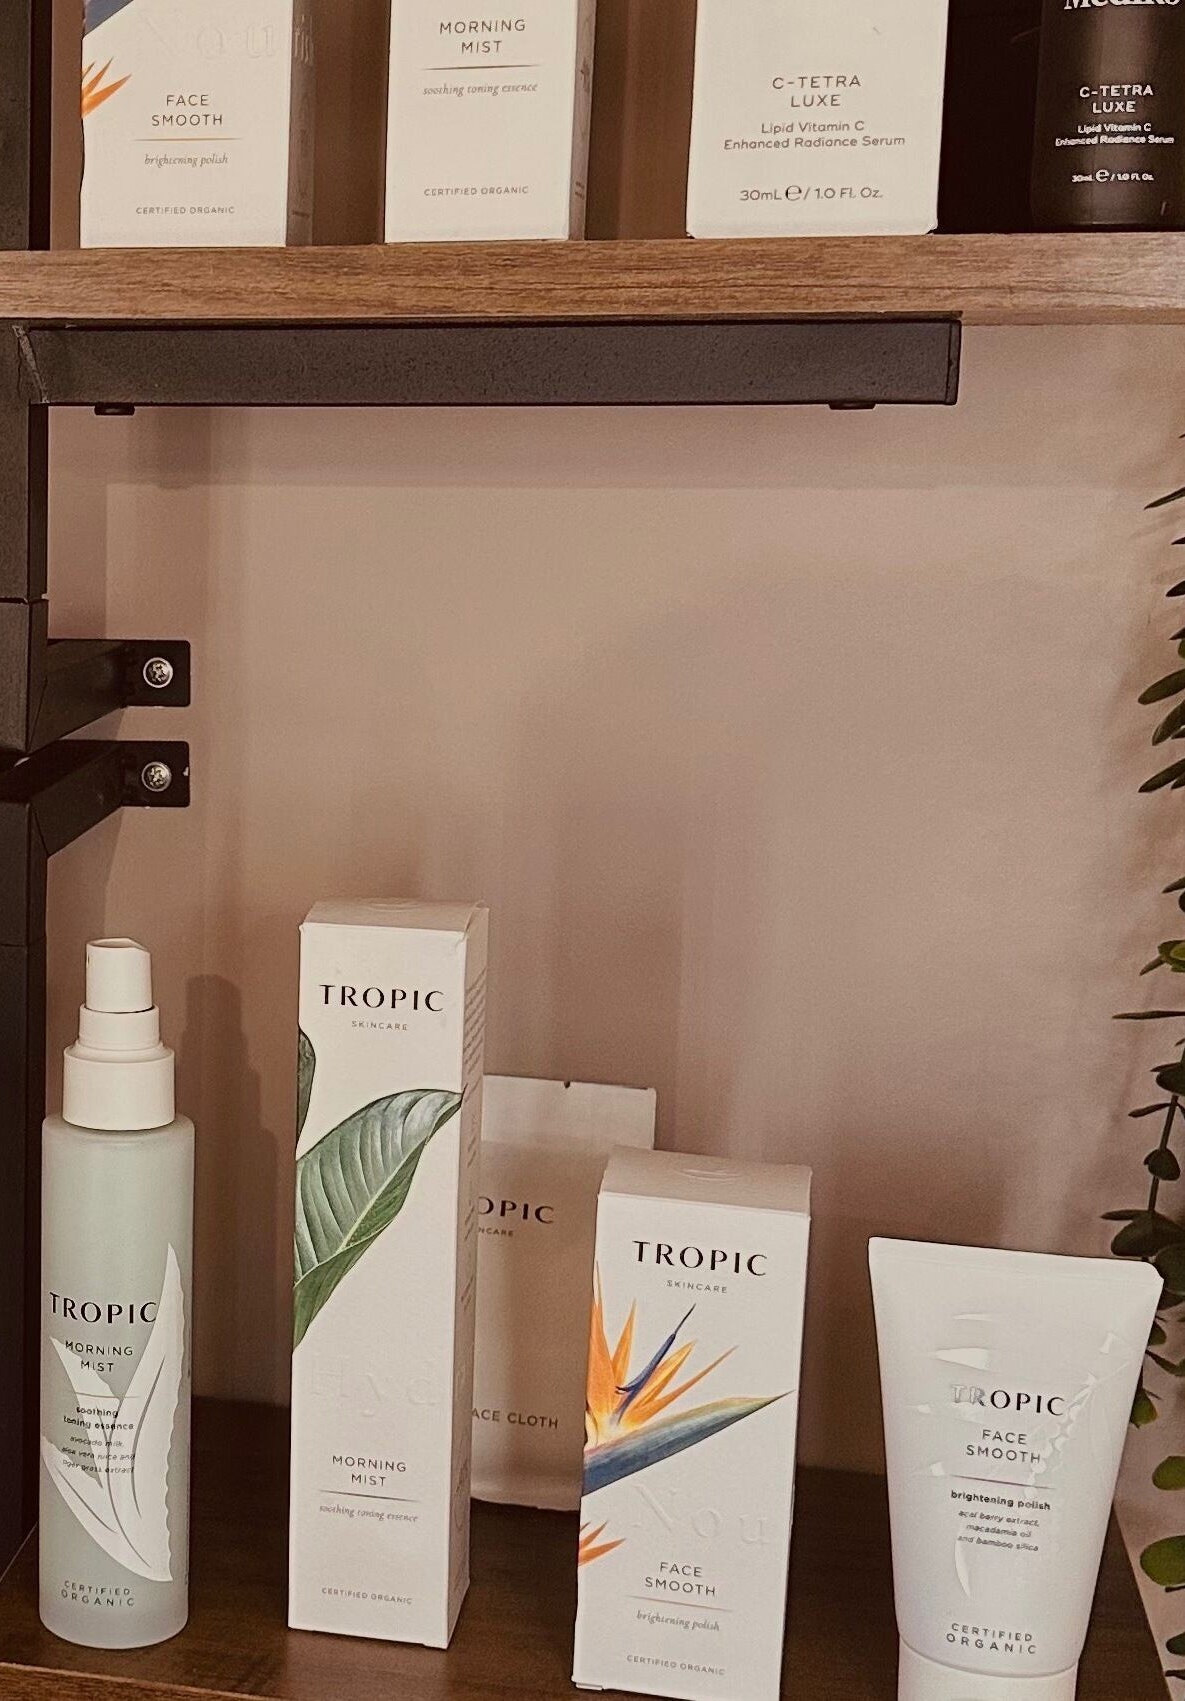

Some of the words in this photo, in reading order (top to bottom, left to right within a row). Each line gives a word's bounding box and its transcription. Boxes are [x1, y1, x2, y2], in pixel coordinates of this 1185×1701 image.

[439, 18, 527, 35] MORNING
[460, 40, 503, 55] MIST
[422, 83, 464, 97] soothing
[467, 83, 500, 97] toning
[502, 82, 538, 94] essence
[772, 75, 861, 90] C-TETRA
[1079, 85, 1154, 98] C-TETRA
[165, 94, 209, 107] FACE
[790, 95, 841, 108] LUXE
[1092, 101, 1136, 114] LUXE
[151, 113, 223, 127] SMOOTH
[761, 121, 794, 134] Lipid
[798, 121, 851, 133] Vitamin
[855, 121, 865, 131] C
[1143, 122, 1152, 132] C
[724, 137, 790, 150] Enhanced
[794, 136, 858, 148] Radiance
[861, 135, 906, 147] Serum
[144, 153, 197, 168] brightening
[199, 153, 229, 167] polish
[423, 187, 478, 197] CERTIFIED
[480, 185, 530, 196] ORGANIC
[135, 206, 186, 216] CERTIFIED
[189, 205, 236, 215] ORGANIC
[319, 984, 445, 1012] TROPIC
[351, 1020, 408, 1031] SKINCARE
[477, 1196, 555, 1225] OPIC
[477, 1226, 515, 1238] NCARE
[632, 1240, 768, 1277] TROPIC
[665, 1279, 728, 1294] SKINCARE
[49, 1291, 158, 1324] TROPIC
[64, 1339, 134, 1356] MORNING
[80, 1359, 115, 1373] MIST
[951, 1384, 1066, 1417] TROPIC
[76, 1406, 119, 1418] soothing
[471, 1408, 501, 1422] ACE
[507, 1412, 560, 1430] CLOTH
[982, 1429, 1028, 1445] FACE
[966, 1444, 1041, 1464] SMOOTH
[331, 1454, 407, 1473] MORNING
[350, 1473, 387, 1487] MIST
[951, 1490, 1014, 1508] brightening
[1017, 1499, 1051, 1511] polish
[319, 1505, 355, 1519] soothing
[386, 1513, 419, 1523] essence
[659, 1561, 703, 1578] FACE
[64, 1580, 131, 1597] CERTIFIED
[644, 1576, 716, 1597] SMOOTH
[61, 1589, 135, 1607] ORGANIC
[321, 1587, 369, 1600] CERTIFIED
[370, 1592, 413, 1606] ORGANIC
[637, 1609, 691, 1631] brightening
[692, 1617, 721, 1632] polish
[951, 1622, 1033, 1642] CERTIFIED
[946, 1633, 1037, 1655] ORGANIC
[627, 1654, 678, 1669] CERTIFIED
[679, 1662, 726, 1676] ORGANIC
